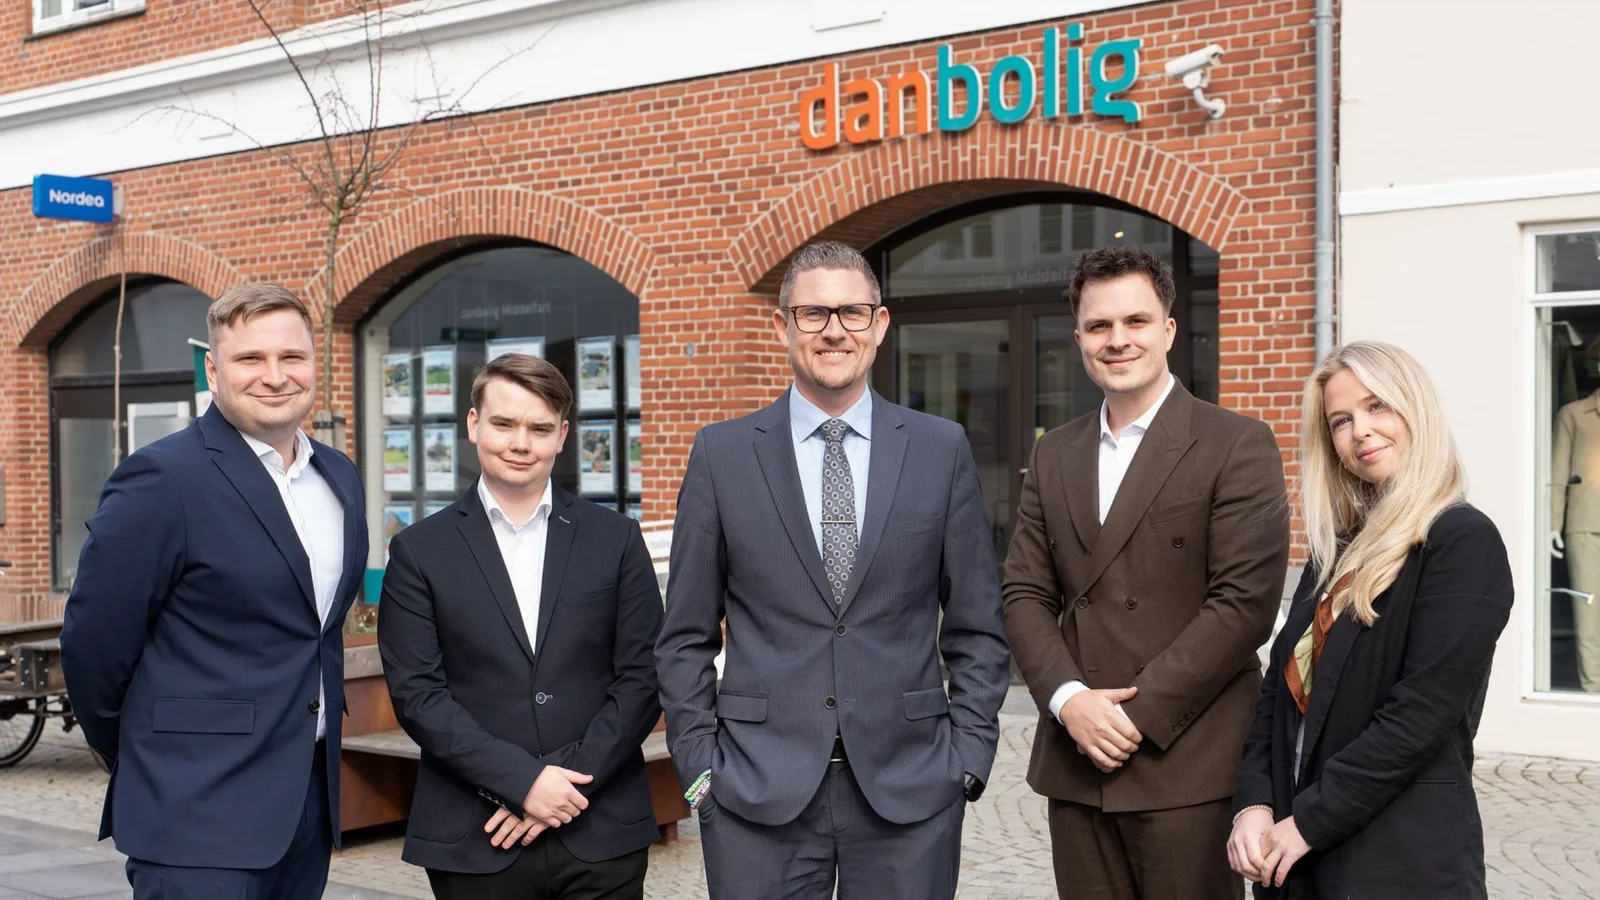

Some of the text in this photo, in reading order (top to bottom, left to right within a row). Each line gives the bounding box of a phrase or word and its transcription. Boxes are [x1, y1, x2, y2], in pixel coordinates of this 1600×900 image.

[800, 23, 1144, 149] danbolig
[49, 188, 105, 208] Nordea
[501, 301, 551, 316] Middelfart
